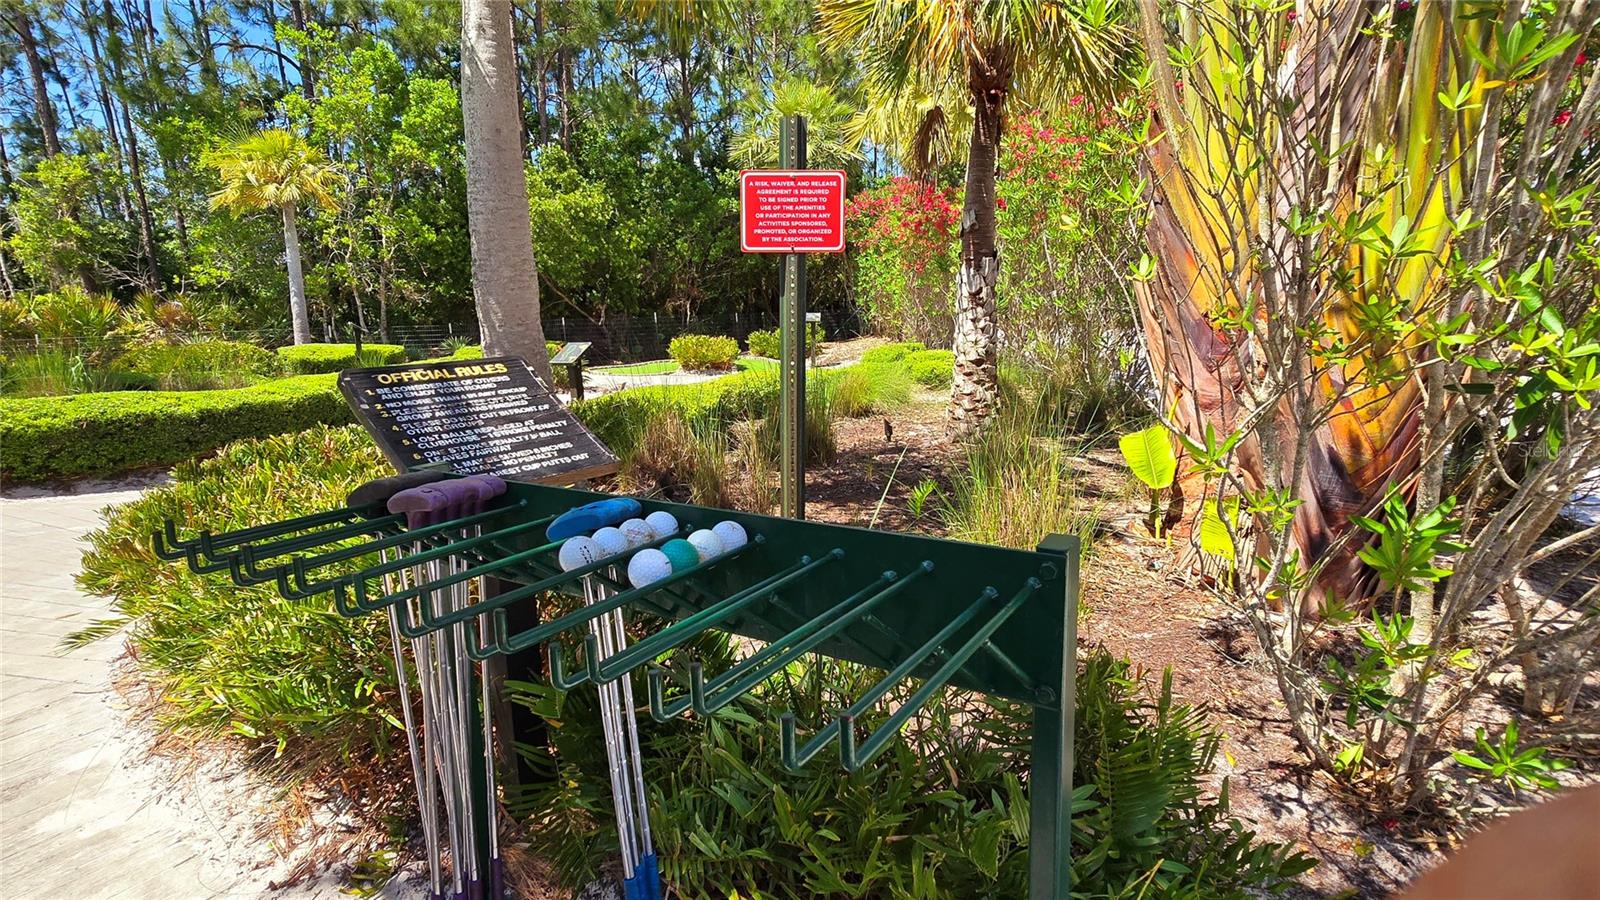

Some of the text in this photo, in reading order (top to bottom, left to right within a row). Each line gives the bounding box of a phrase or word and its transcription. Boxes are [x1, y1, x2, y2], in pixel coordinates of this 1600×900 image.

[376, 387, 393, 395] BE
[393, 379, 460, 393] CONSIDERATE
[460, 378, 473, 386] OF
[474, 375, 511, 384] OTHERS
[377, 363, 508, 385] OFFICIAL RULES
[381, 383, 497, 400] AND ENJOY YOUR ROUND
[385, 401, 402, 409] NO
[403, 398, 434, 407] MORE
[433, 395, 460, 404] THAN
[478, 390, 496, 398] ANY
[497, 386, 528, 395] GROUP
[391, 405, 430, 416] PLEASE
[396, 400, 529, 422] GROUP AHEAD HAS FINISHED
[401, 418, 442, 431] PLEASE
[458, 414, 478, 422] NOT
[479, 411, 499, 420] CUT
[509, 405, 538, 415] FRONT
[402, 438, 413, 446] 5.
[412, 434, 440, 444] LOST
[441, 428, 474, 440] BALLS
[474, 421, 523, 434] REPLACED
[406, 420, 485, 436] OTHER GROUPS
[417, 434, 481, 450] CLUBHOUSE
[494, 427, 530, 438] STROKE
[530, 420, 568, 432] PENALTY
[424, 449, 448, 458] ONE
[448, 441, 489, 454] STROKE
[488, 434, 530, 447] PENALTY
[540, 430, 564, 438] BALL
[428, 444, 512, 464] LEAVES FAIRWAY
[463, 458, 484, 468] MAY
[498, 449, 533, 461] MOVED
[538, 442, 574, 453] INCHES
[502, 458, 518, 467] NO
[518, 451, 559, 464] PENALTY
[520, 462, 542, 472] CUP
[541, 457, 572, 467] PUTTS
[572, 452, 590, 461] OUT
